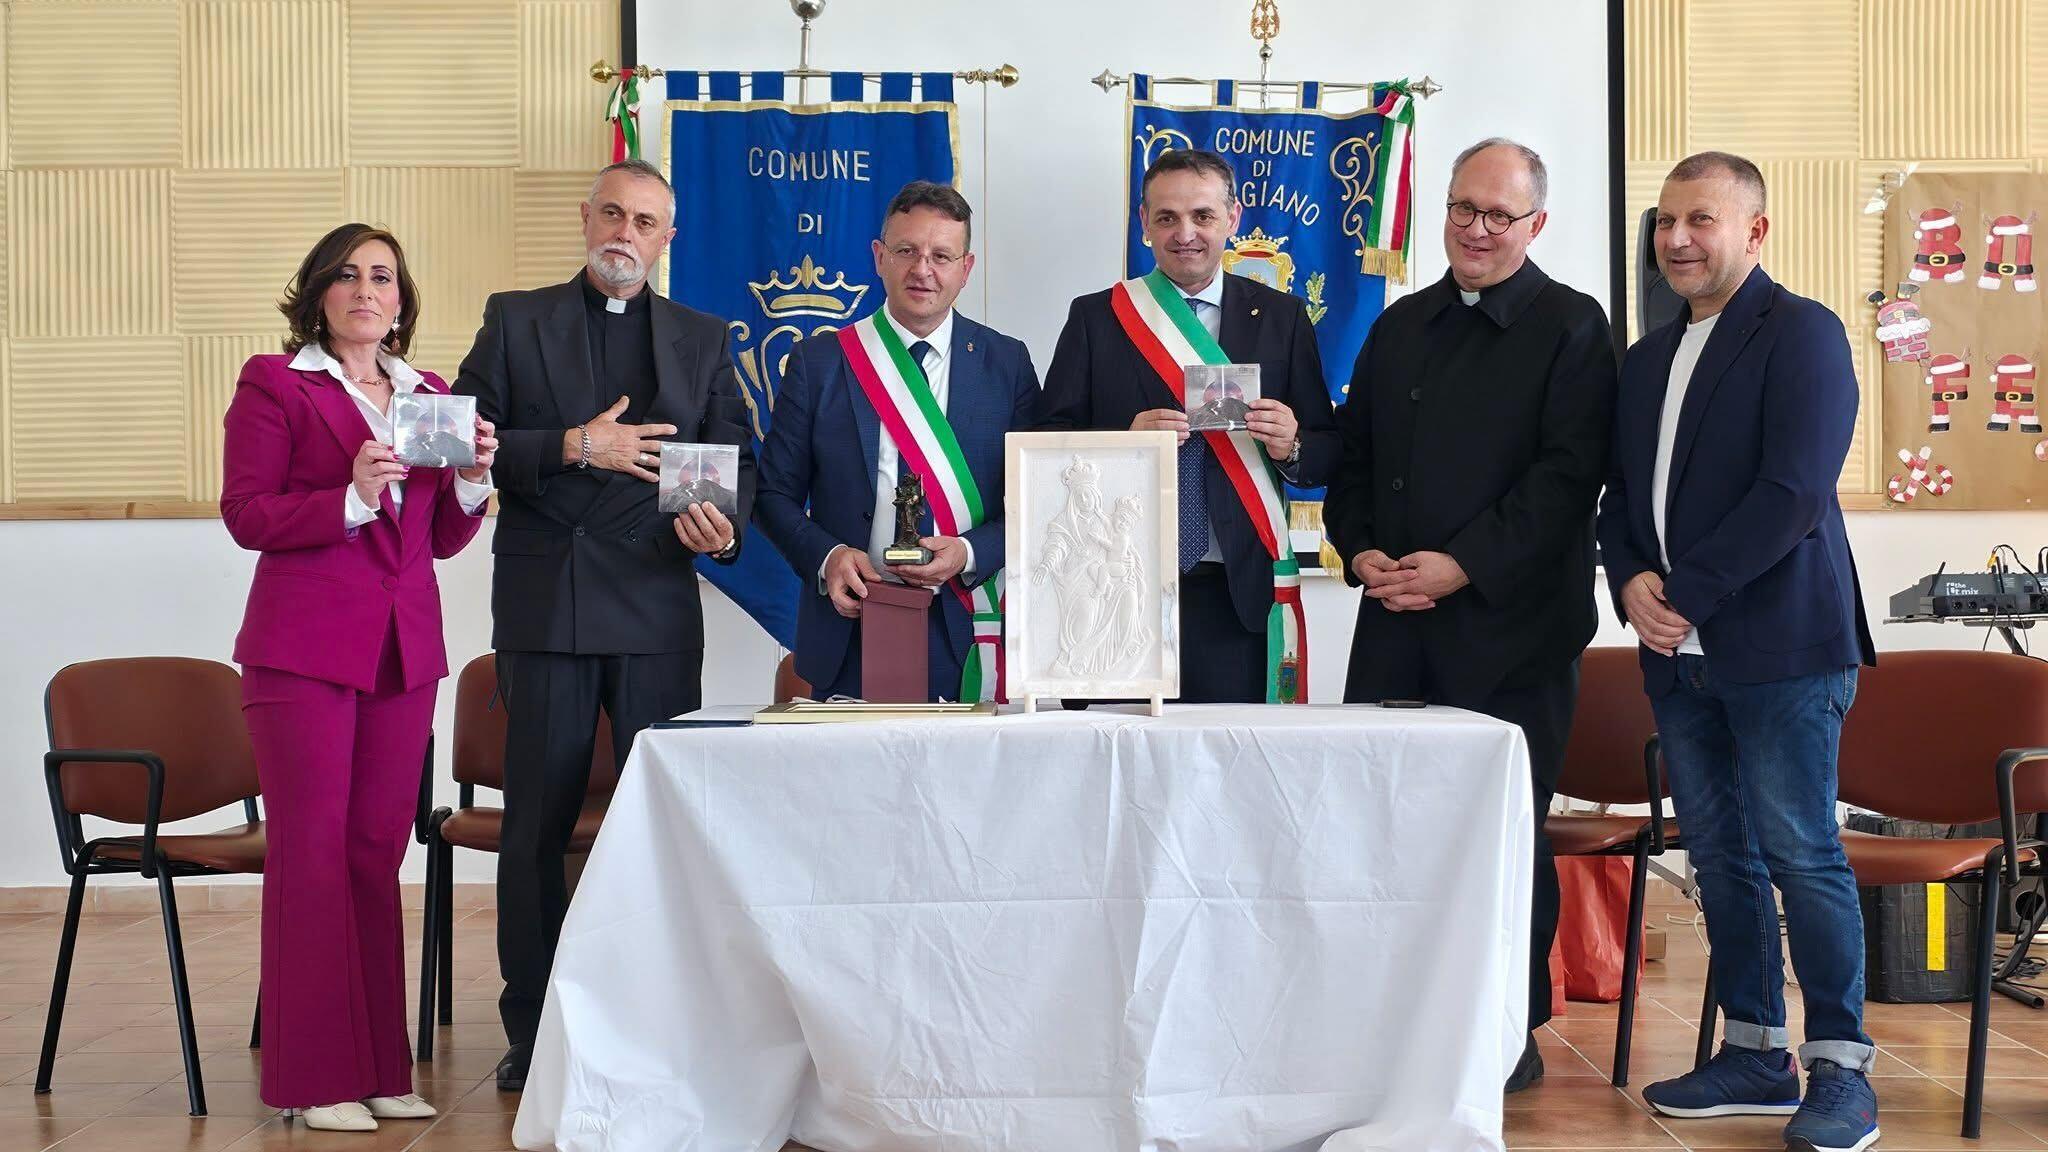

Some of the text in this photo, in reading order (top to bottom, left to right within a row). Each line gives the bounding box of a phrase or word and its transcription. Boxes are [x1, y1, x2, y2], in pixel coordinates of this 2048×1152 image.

[1215, 127, 1316, 157] COMUNE
[748, 146, 871, 182] COMUNE
[1252, 160, 1272, 177] DI
[797, 213, 823, 235] DI
